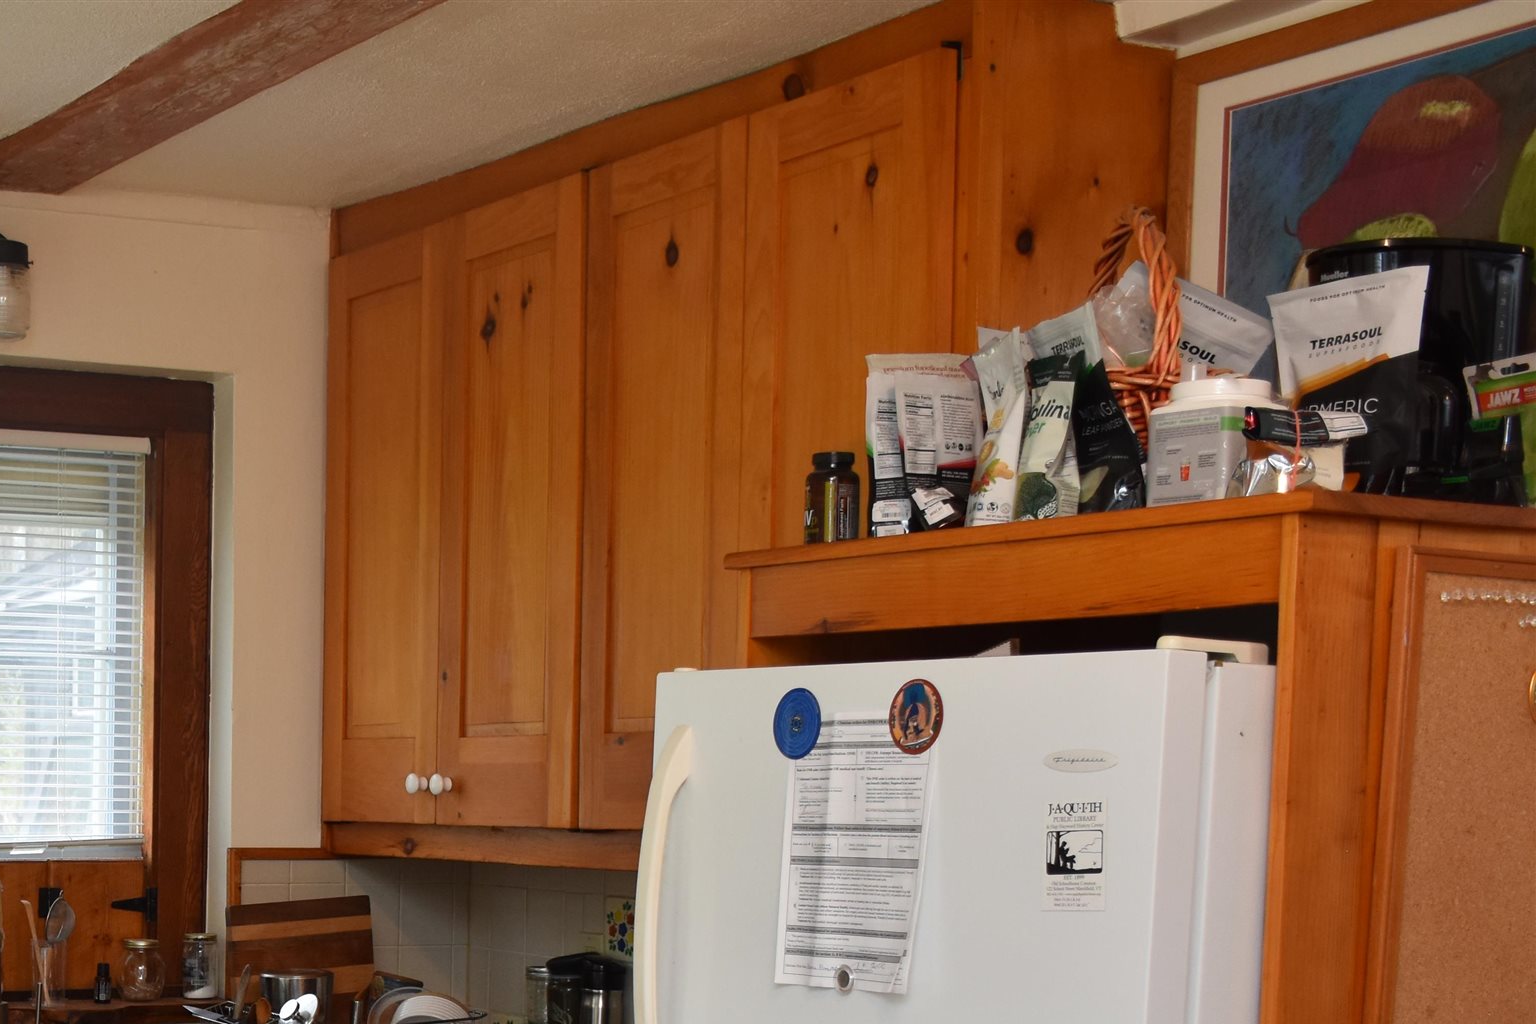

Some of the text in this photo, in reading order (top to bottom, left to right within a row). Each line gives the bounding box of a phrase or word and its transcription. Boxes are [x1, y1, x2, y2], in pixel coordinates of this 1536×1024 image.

[1309, 326, 1383, 350] TERRASOUL
[1177, 338, 1217, 365] SOUL
[1488, 387, 1521, 409] JAWZ
